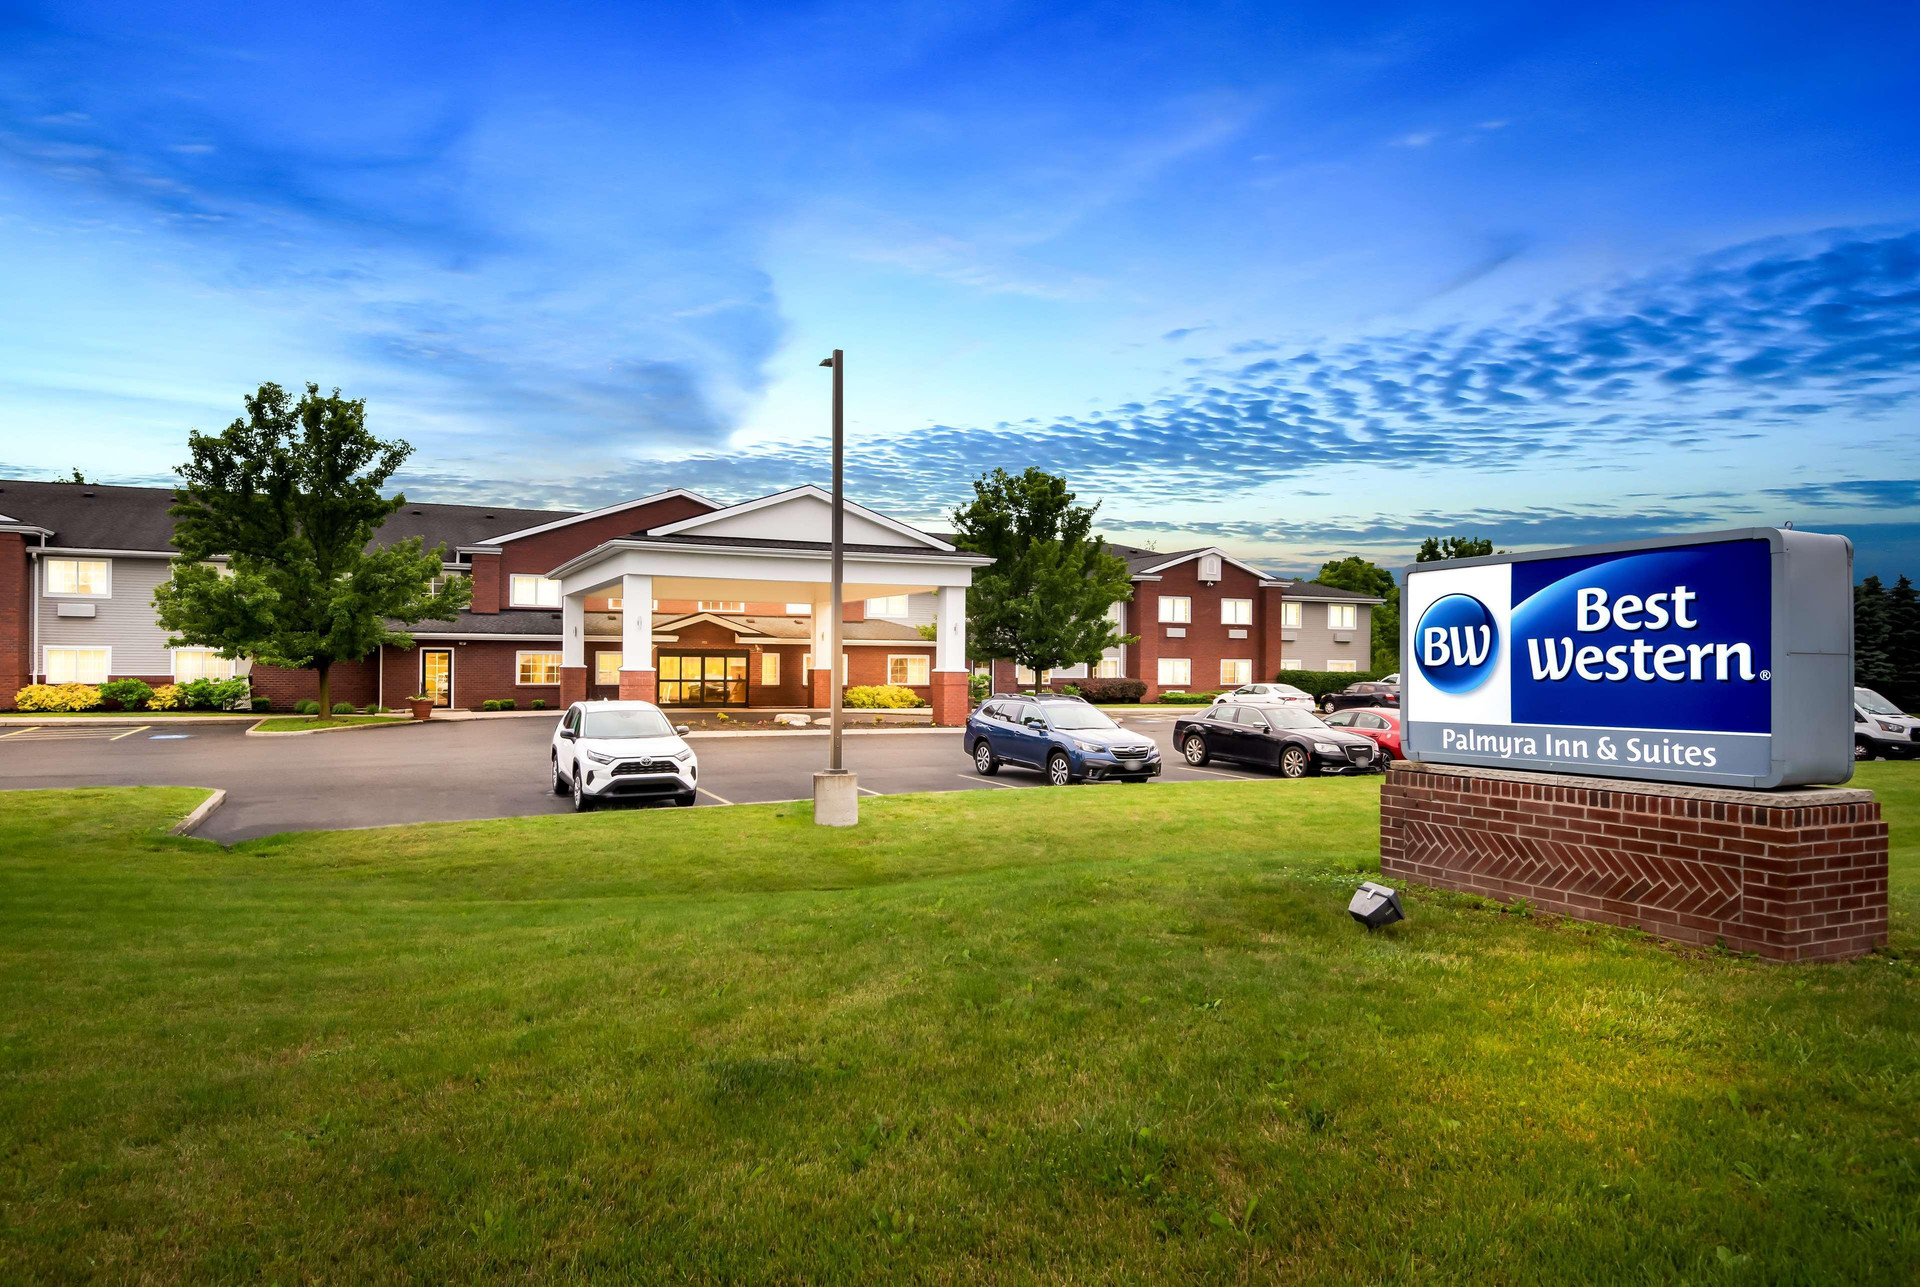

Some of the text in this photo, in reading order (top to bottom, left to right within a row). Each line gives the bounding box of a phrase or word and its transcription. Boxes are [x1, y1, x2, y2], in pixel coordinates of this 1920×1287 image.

[1577, 585, 1698, 632] Best
[1423, 624, 1491, 667] BW
[1442, 728, 1717, 767] Palmyra Inn & Suites
